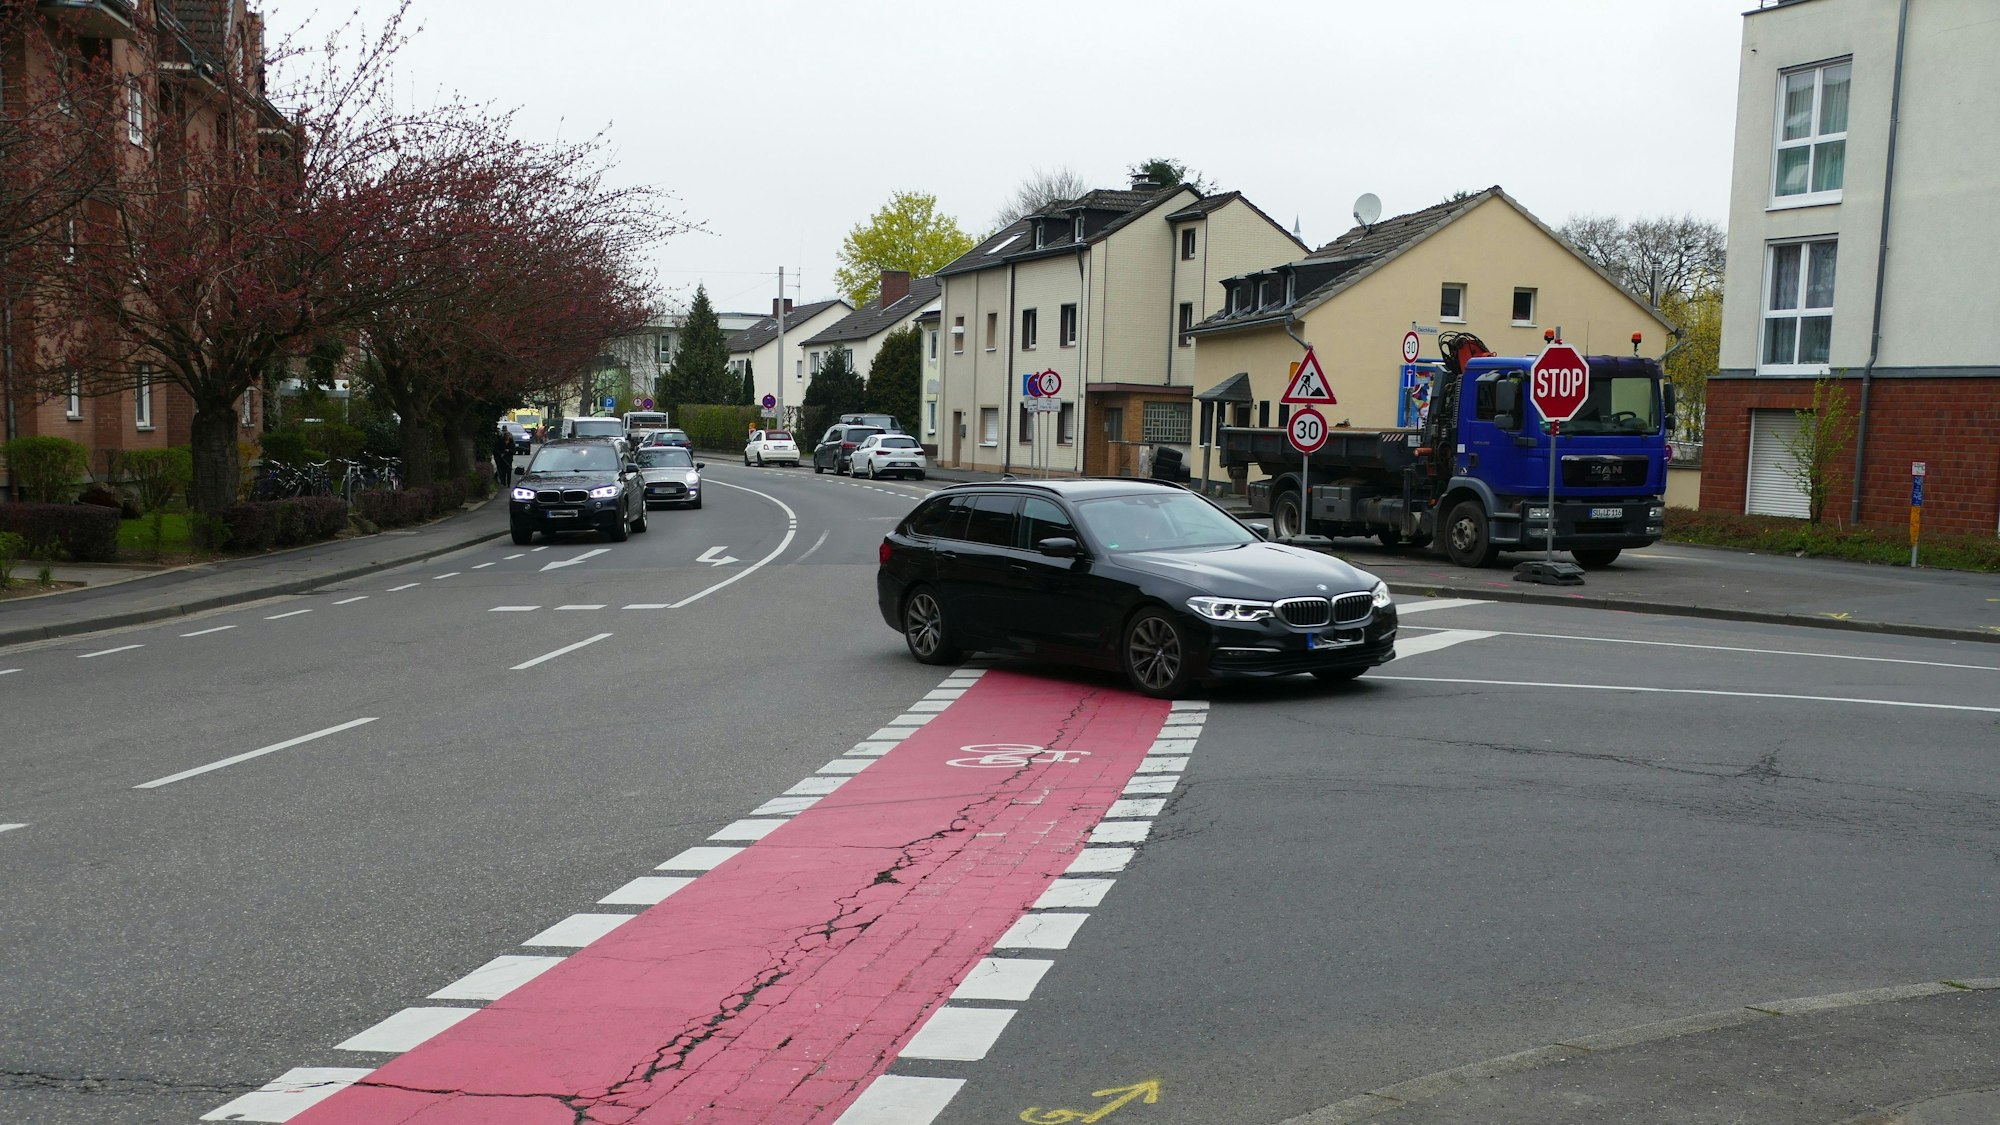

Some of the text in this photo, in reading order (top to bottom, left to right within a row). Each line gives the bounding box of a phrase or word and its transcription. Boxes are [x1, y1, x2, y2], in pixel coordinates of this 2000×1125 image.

[1406, 341, 1416, 354] 30
[1536, 368, 1584, 398] STOP
[606, 398, 613, 407] P
[1296, 420, 1319, 440] 30
[1591, 465, 1623, 474] MAN
